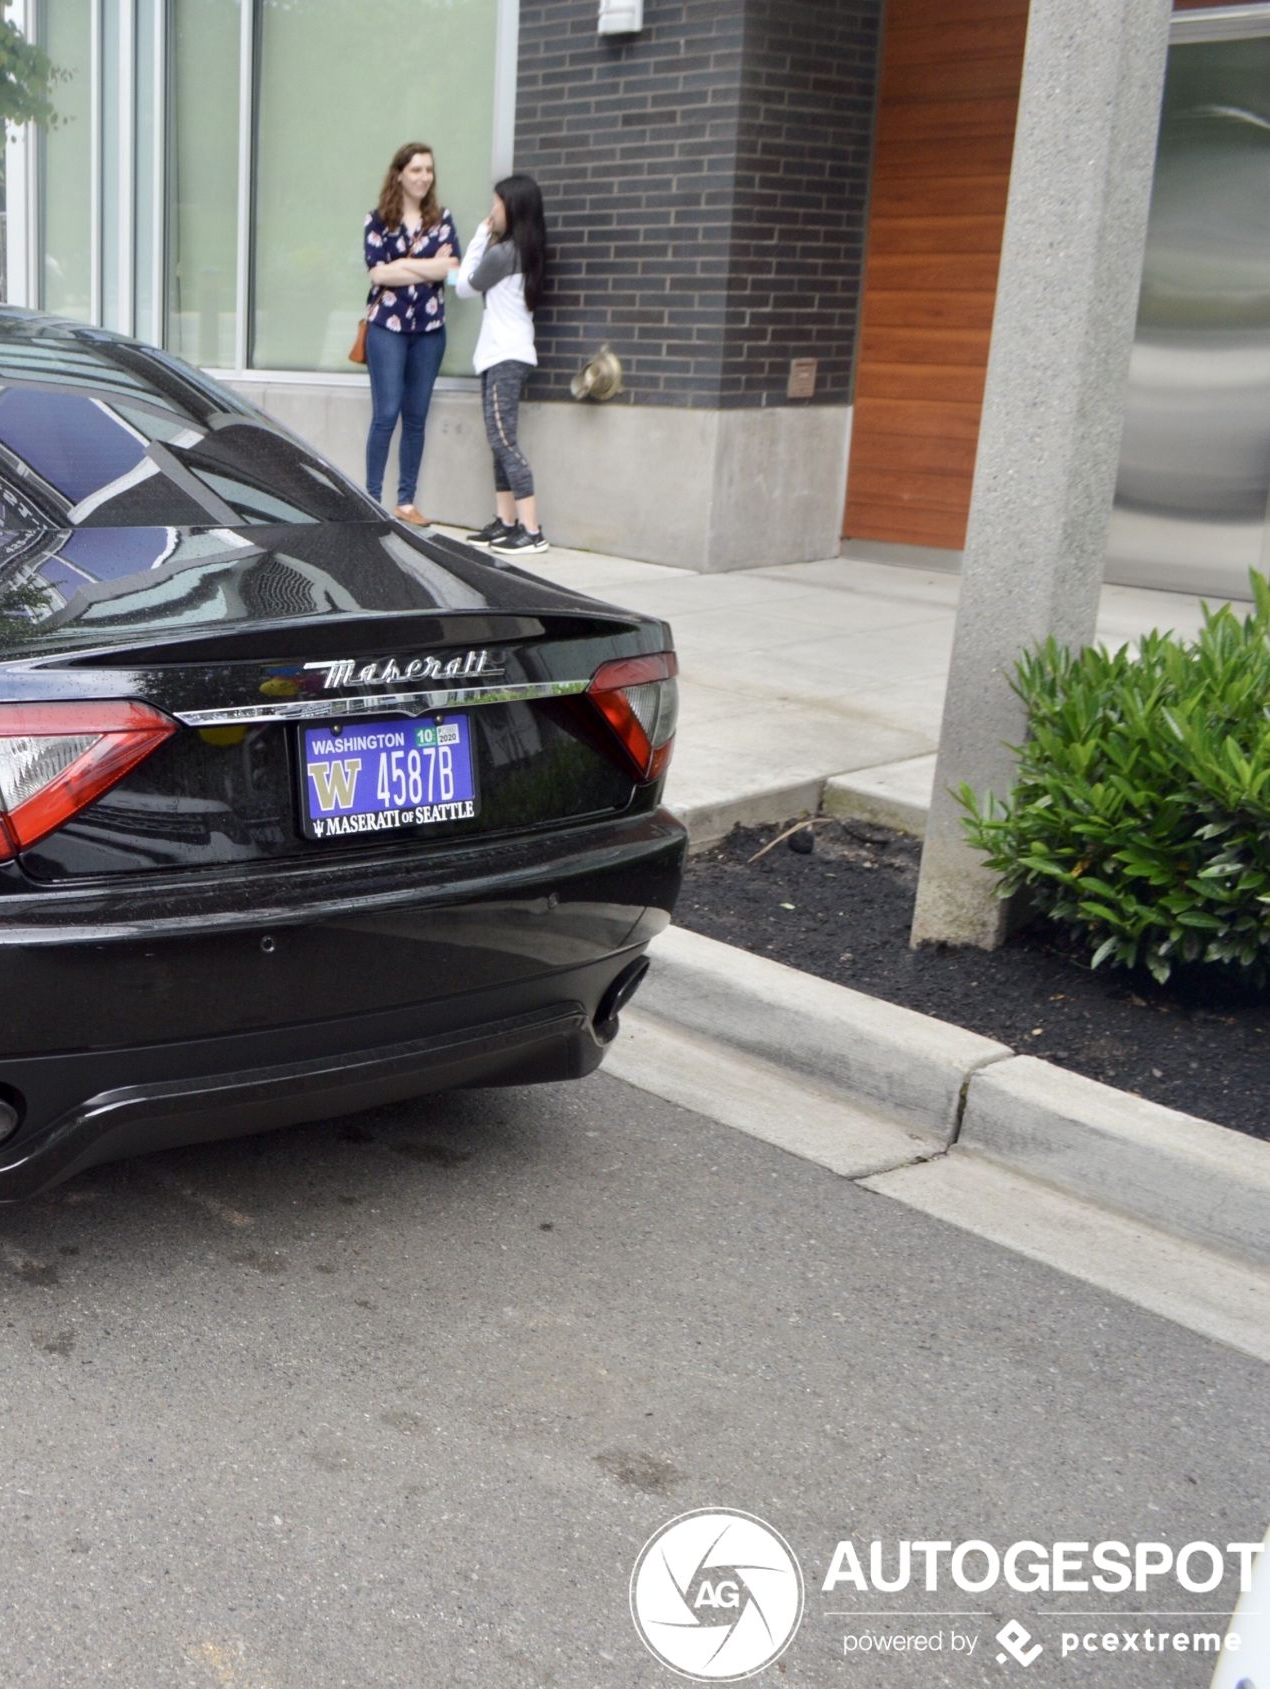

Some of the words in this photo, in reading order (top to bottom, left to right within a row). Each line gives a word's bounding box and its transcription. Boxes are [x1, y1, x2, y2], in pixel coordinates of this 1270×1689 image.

[304, 650, 505, 689] Maserati
[312, 732, 405, 755] WASHINGTON
[417, 729, 433, 743] 10
[439, 733, 457, 743] 2020
[307, 758, 362, 811] W
[377, 746, 454, 807] 4587B
[326, 810, 401, 836] MASERATI
[415, 801, 475, 824] SEATTLE
